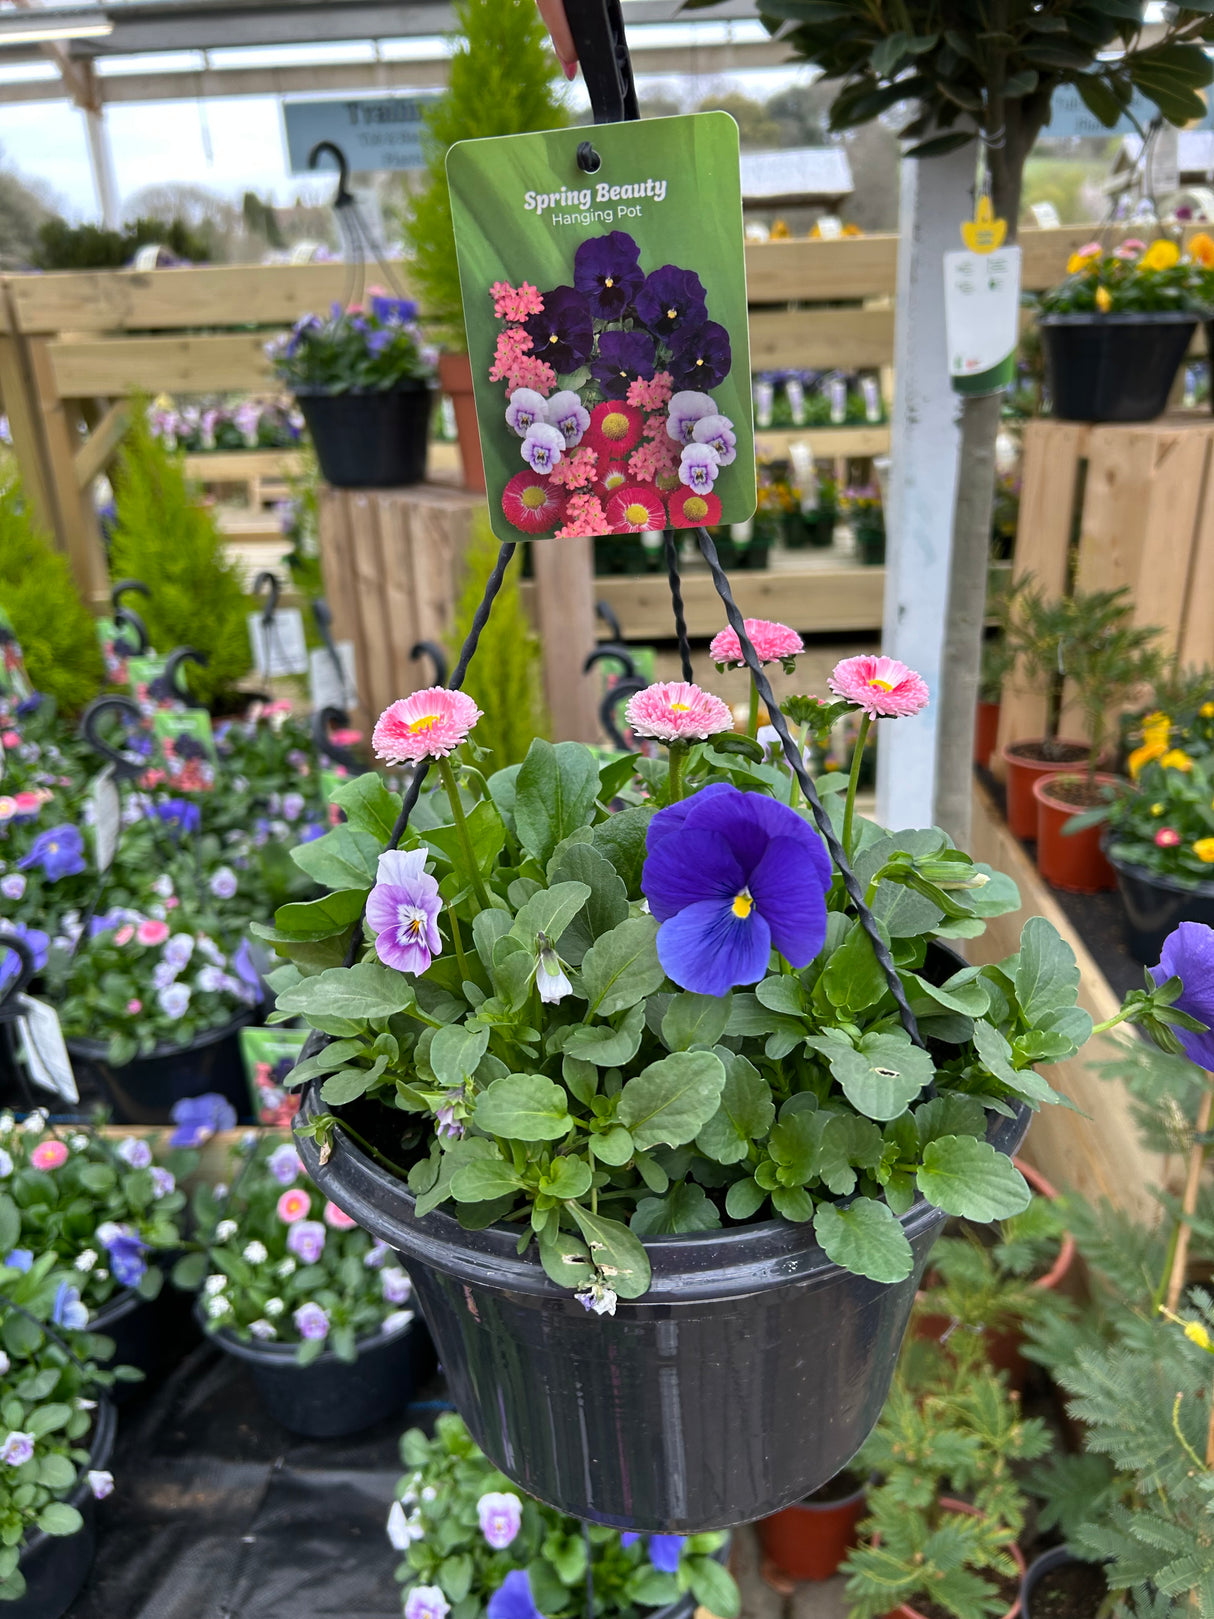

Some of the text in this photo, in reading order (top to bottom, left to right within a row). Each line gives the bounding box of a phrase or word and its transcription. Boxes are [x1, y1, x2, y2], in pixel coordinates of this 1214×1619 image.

[523, 179, 668, 215] Spring Beauty
[551, 205, 643, 226] Hanging Pot
